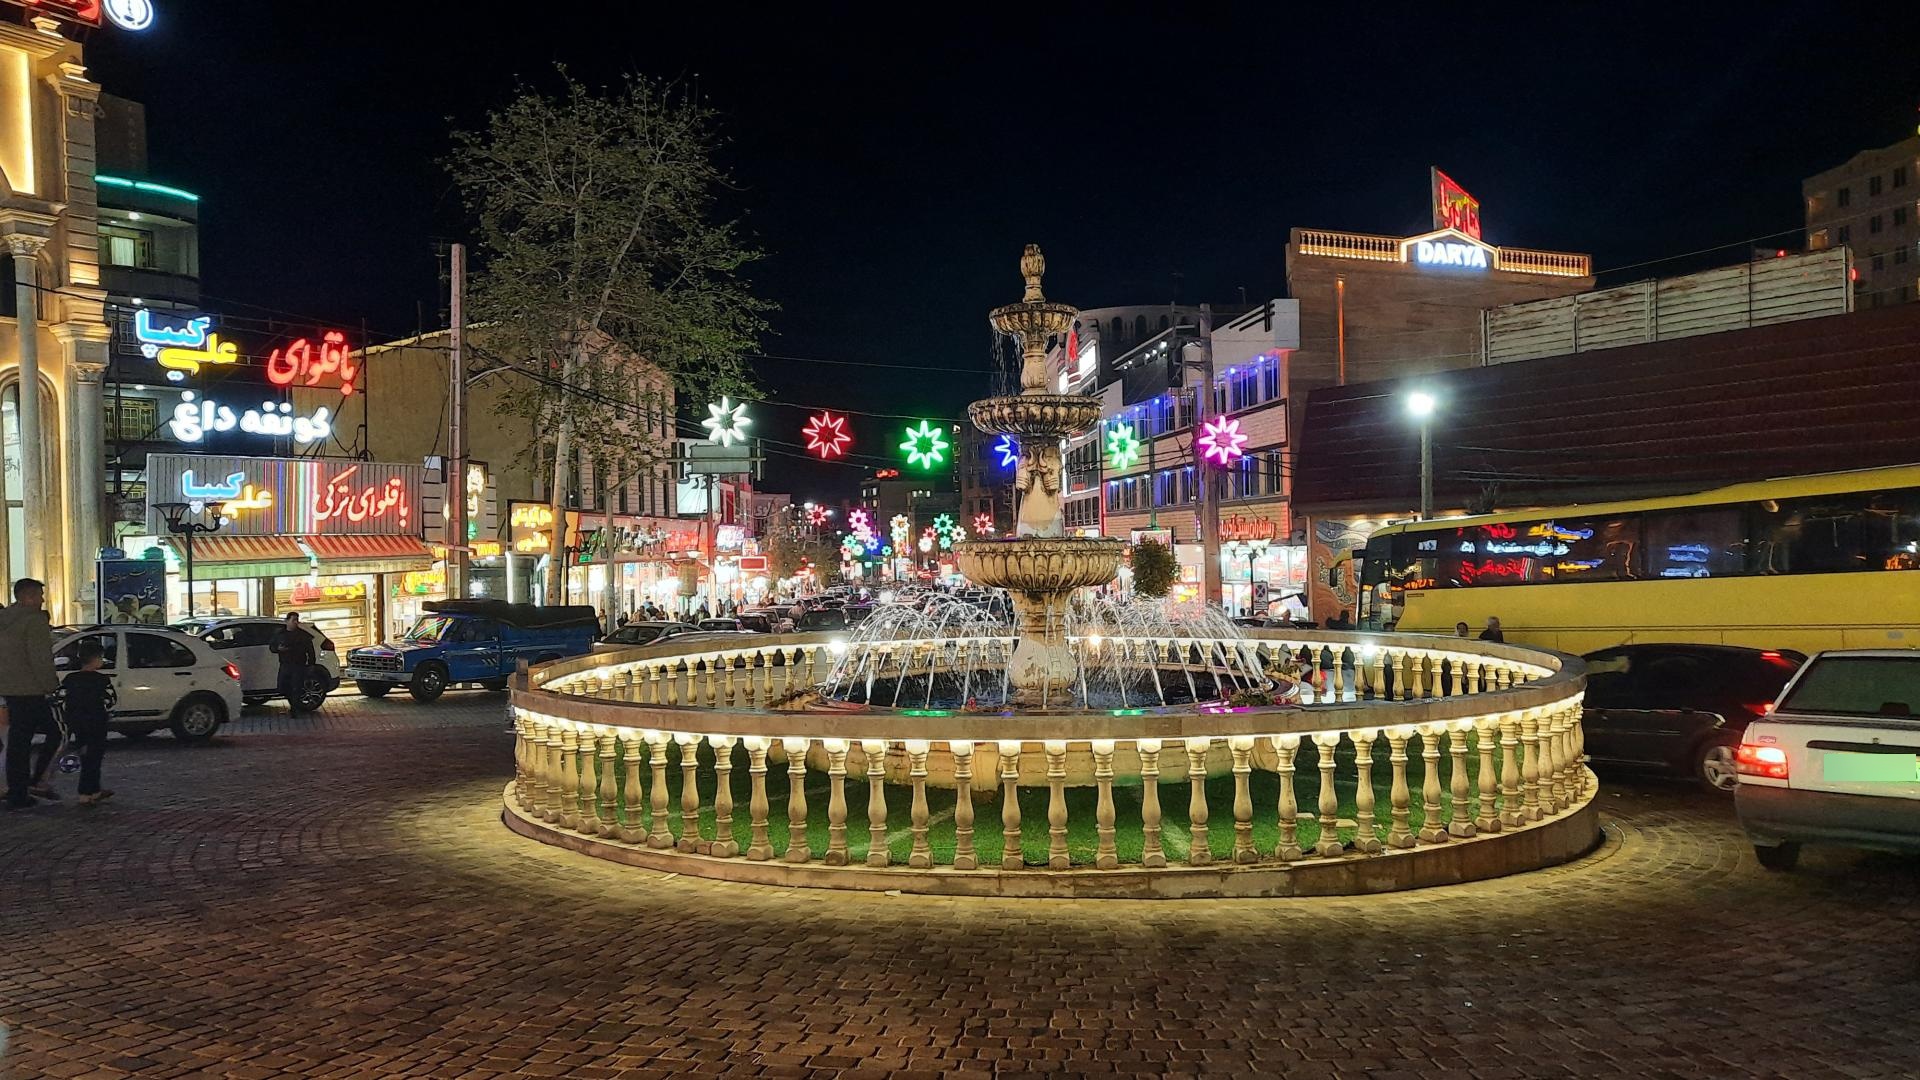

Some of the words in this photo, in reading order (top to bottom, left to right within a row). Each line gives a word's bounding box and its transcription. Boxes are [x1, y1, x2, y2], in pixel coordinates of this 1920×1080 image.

[1417, 241, 1487, 269] DARYA
[267, 331, 355, 395] باقلوای
[169, 390, 237, 443] داغ
[239, 401, 331, 443] کونفه
[314, 465, 357, 521] ترکی
[347, 478, 409, 527] باقلوای
